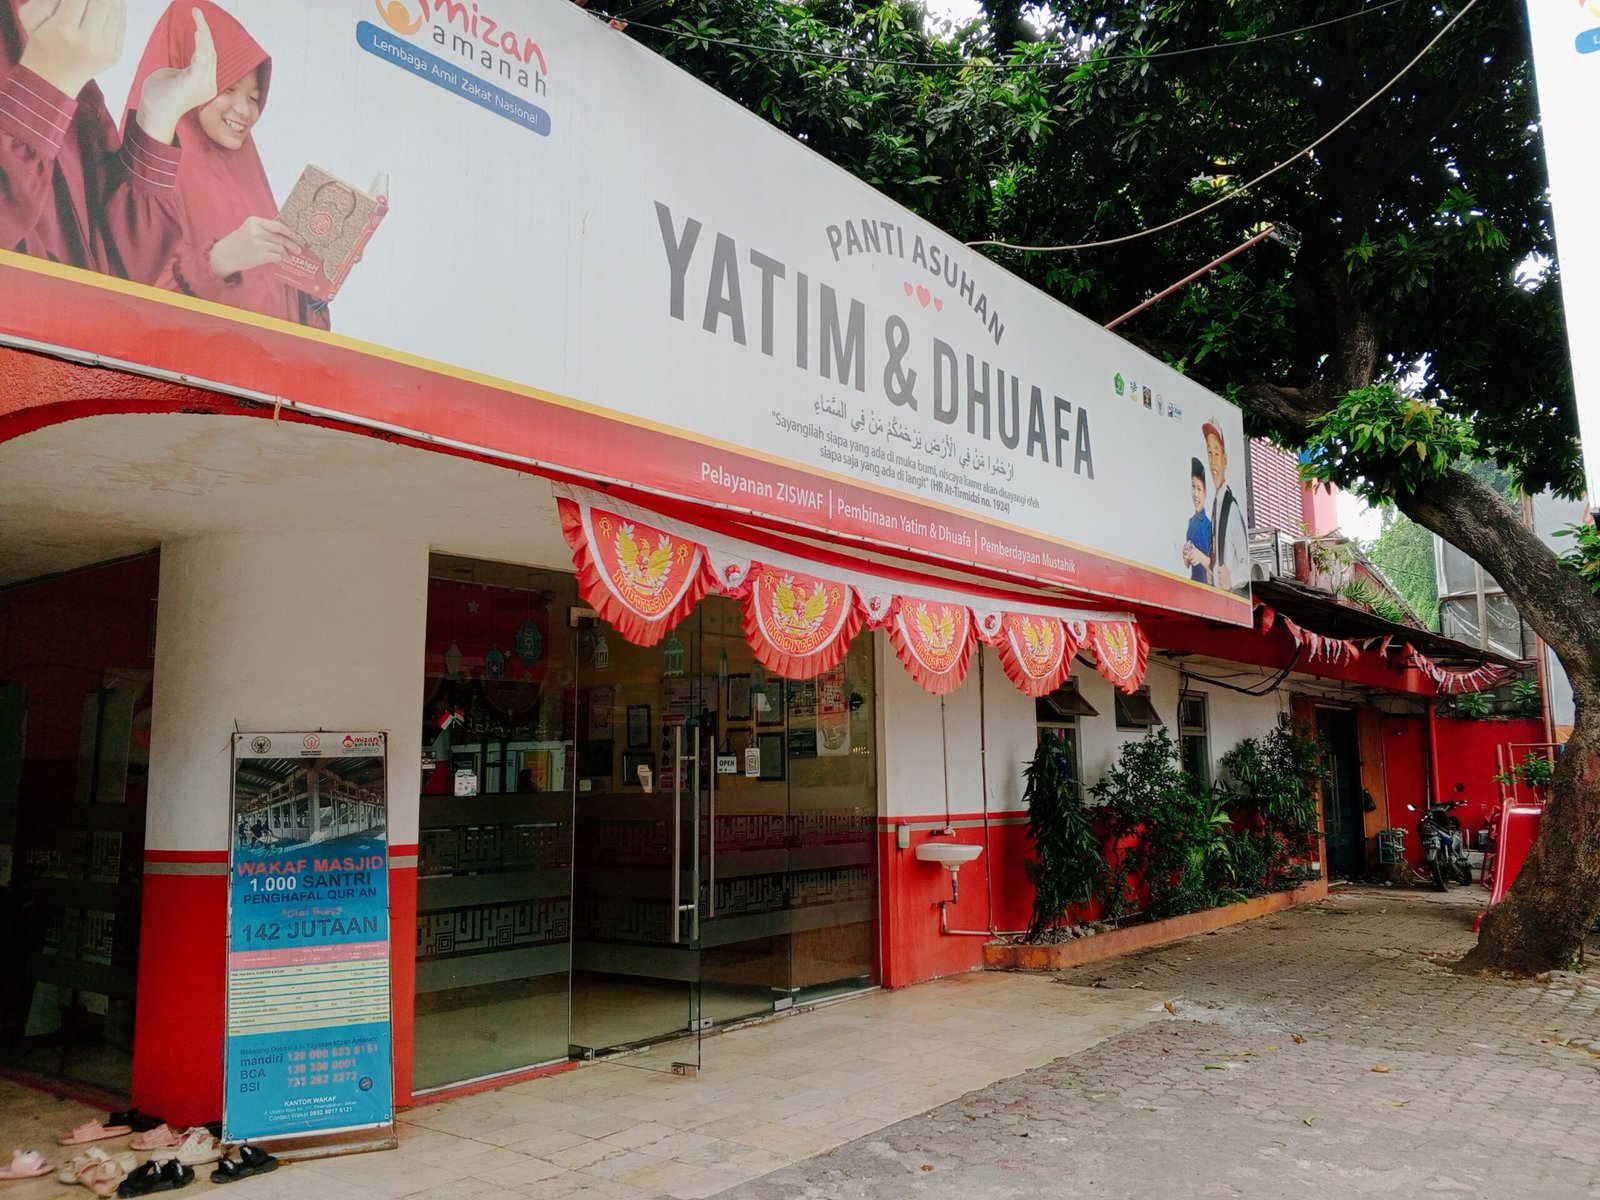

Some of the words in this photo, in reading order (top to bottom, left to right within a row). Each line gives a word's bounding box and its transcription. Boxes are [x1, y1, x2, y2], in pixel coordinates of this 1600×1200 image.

[434, 0, 548, 76] mizan
[432, 25, 547, 97] amanah
[373, 34, 428, 71] Lembaga
[431, 64, 457, 85] Amil
[461, 77, 491, 102] Zakat
[495, 95, 538, 125] Nasional
[825, 217, 904, 262] PANTI
[911, 234, 1006, 347] ASUHAN
[653, 200, 866, 393] YATIM
[883, 314, 918, 413] &
[933, 337, 1095, 480] DHUAFA
[819, 445, 842, 463] siapa
[842, 453, 859, 469] saja
[859, 460, 880, 477] yang
[880, 465, 896, 479] ada
[896, 468, 905, 480] di
[930, 479, 943, 493] (HR
[944, 482, 981, 505] At-Tirmidzi
[981, 496, 992, 508] no.
[992, 498, 1011, 515] 1924)
[826, 430, 848, 449] siapa
[849, 440, 870, 458] yang
[870, 446, 886, 460] ada
[886, 450, 895, 463] di
[895, 455, 917, 470] muka
[917, 459, 938, 478] bumi,
[939, 468, 963, 486] niscaya
[963, 474, 982, 490] kamu
[982, 482, 998, 496] akan
[998, 486, 1027, 507] disayangi
[1027, 497, 1040, 510] oleh
[700, 461, 773, 499] Pelayanan
[776, 482, 824, 511] ZISWAF
[837, 498, 898, 530] Pembinaan
[899, 514, 928, 538] Yatim
[929, 522, 937, 538] &
[938, 524, 971, 548] Dhuafa
[980, 536, 1041, 565] Pemberdayaan
[1041, 553, 1076, 574] Mustahik
[611, 569, 673, 615] INDONESIA
[764, 615, 829, 655] INDONESIA
[354, 735, 379, 743] mizan
[719, 759, 735, 767] OPEN
[237, 858, 307, 876] WAKAF
[313, 855, 384, 872] MASJID
[249, 876, 297, 892] 1.000
[302, 872, 371, 889] SANTRI
[243, 891, 324, 904] PENGHAFAL
[327, 887, 377, 900] QUR'AN
[242, 922, 281, 942] 142
[287, 915, 378, 939] JUTAAN
[239, 1068, 266, 1081] BCA
[240, 1054, 283, 1067] mandiri
[239, 1082, 260, 1094] BSI
[284, 1098, 312, 1107] KANTOR
[312, 1095, 337, 1104] WAKAF
